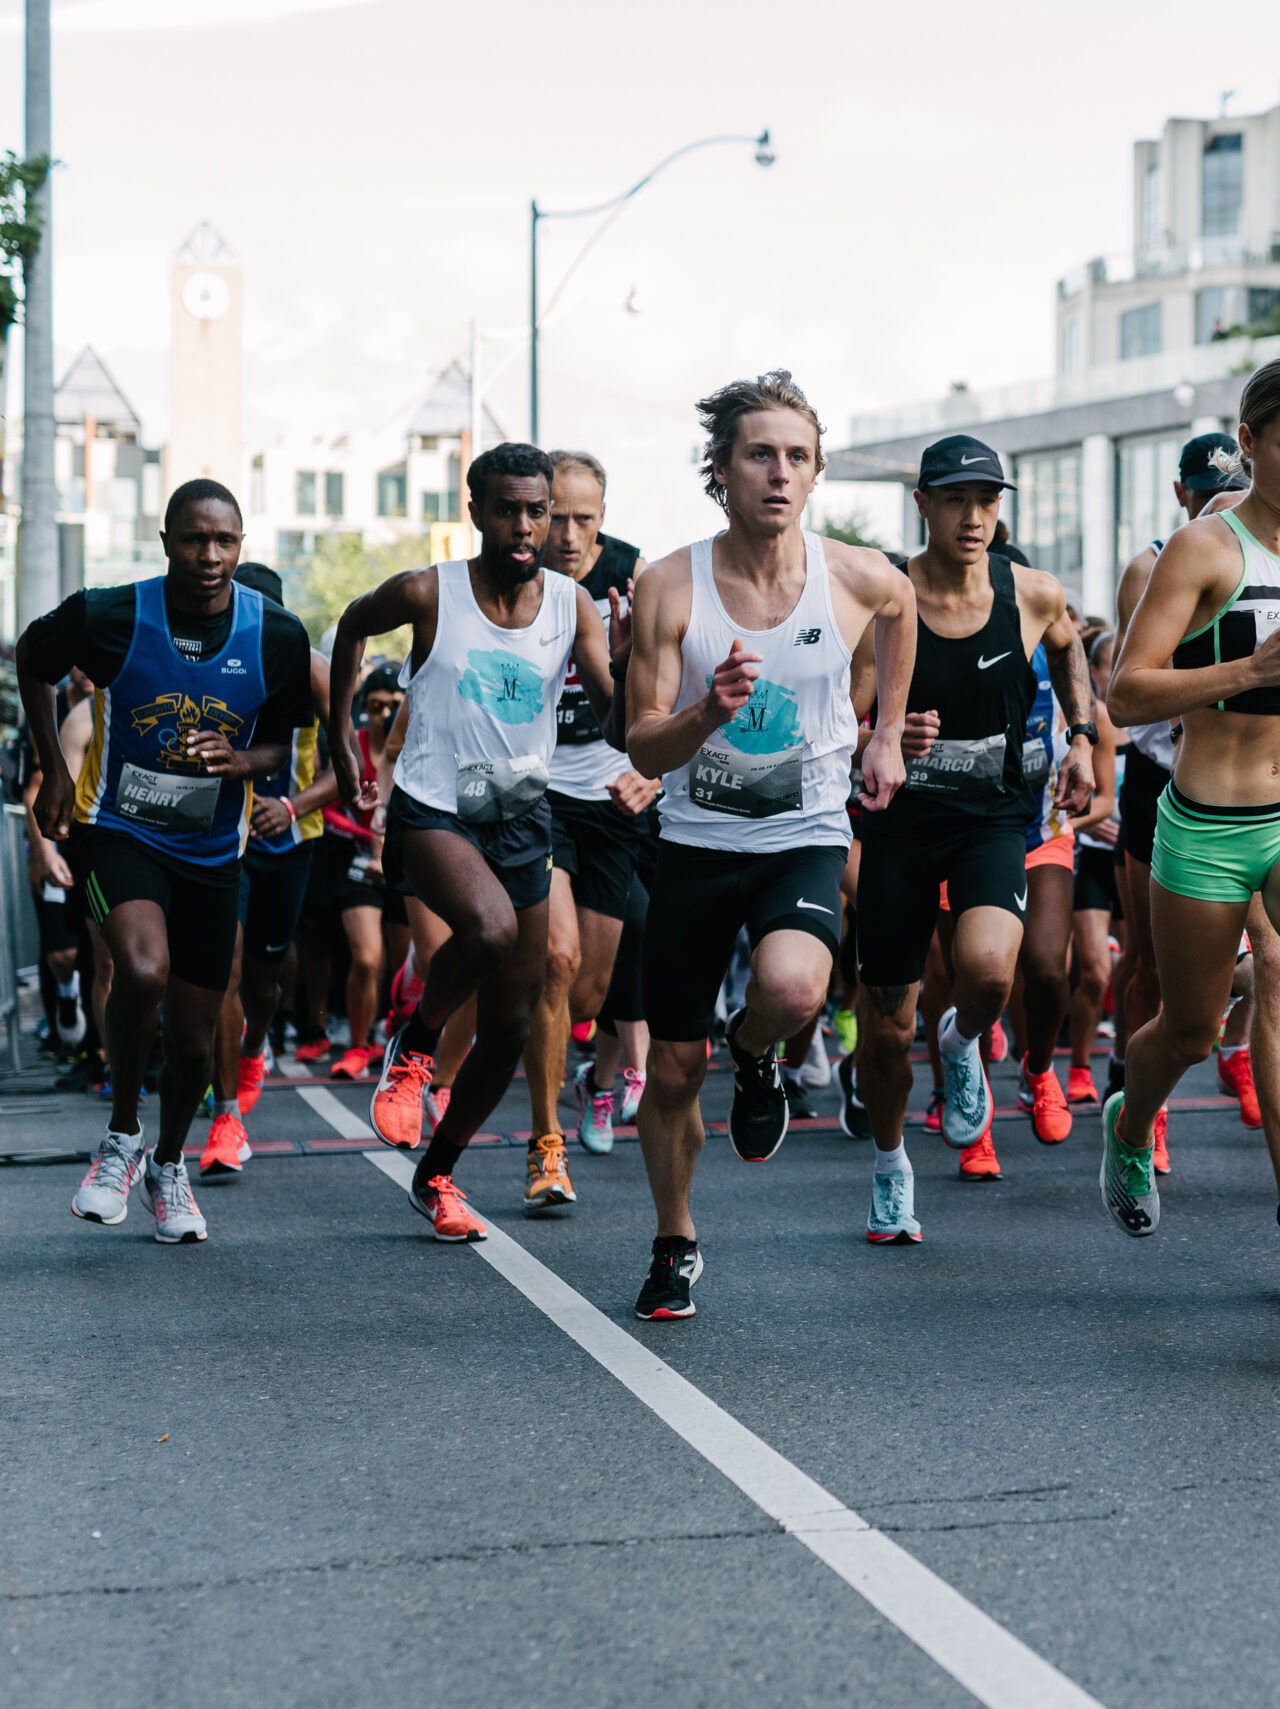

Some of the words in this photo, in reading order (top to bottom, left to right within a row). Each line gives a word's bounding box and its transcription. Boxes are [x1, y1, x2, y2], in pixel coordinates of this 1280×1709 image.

[557, 709, 575, 724] 15
[701, 748, 729, 761] EXACT
[467, 763, 495, 773] EXACT
[911, 756, 975, 772] MARCO
[132, 770, 158, 782] EXACT
[695, 765, 744, 790] KYLE
[910, 771, 929, 782] 39
[123, 783, 184, 808] HENRY
[464, 781, 487, 797] 48
[695, 787, 713, 801] 31
[120, 802, 139, 815] 43
